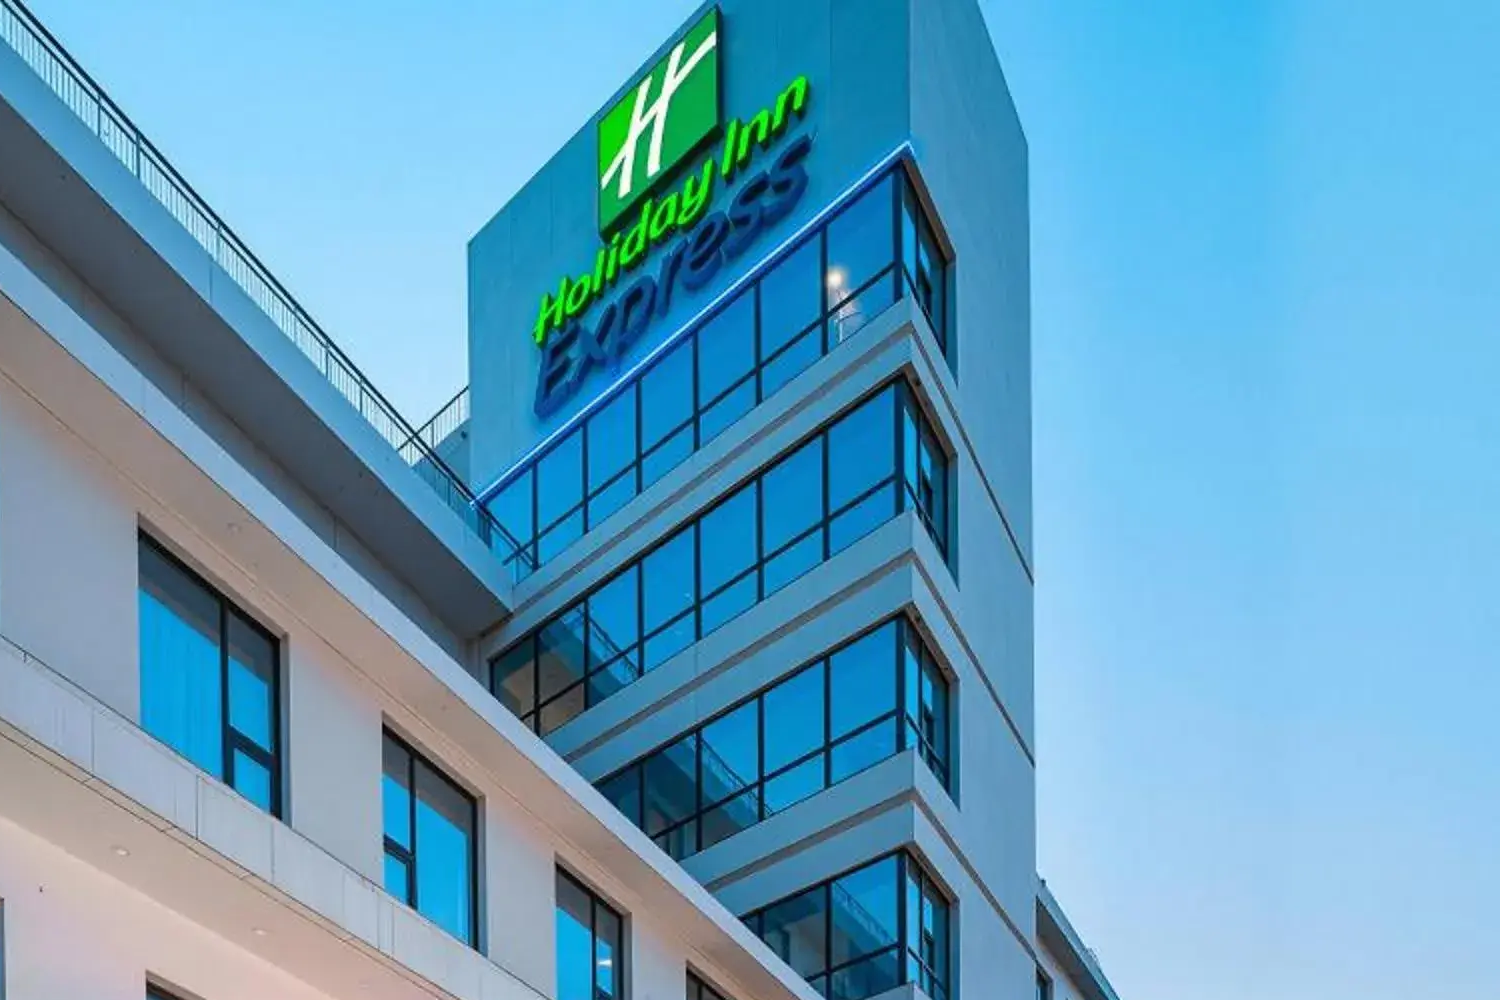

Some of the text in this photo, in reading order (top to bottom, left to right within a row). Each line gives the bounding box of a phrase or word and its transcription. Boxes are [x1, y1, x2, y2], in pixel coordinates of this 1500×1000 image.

[534, 75, 811, 348] Holiday Inn
[601, 31, 717, 199] H
